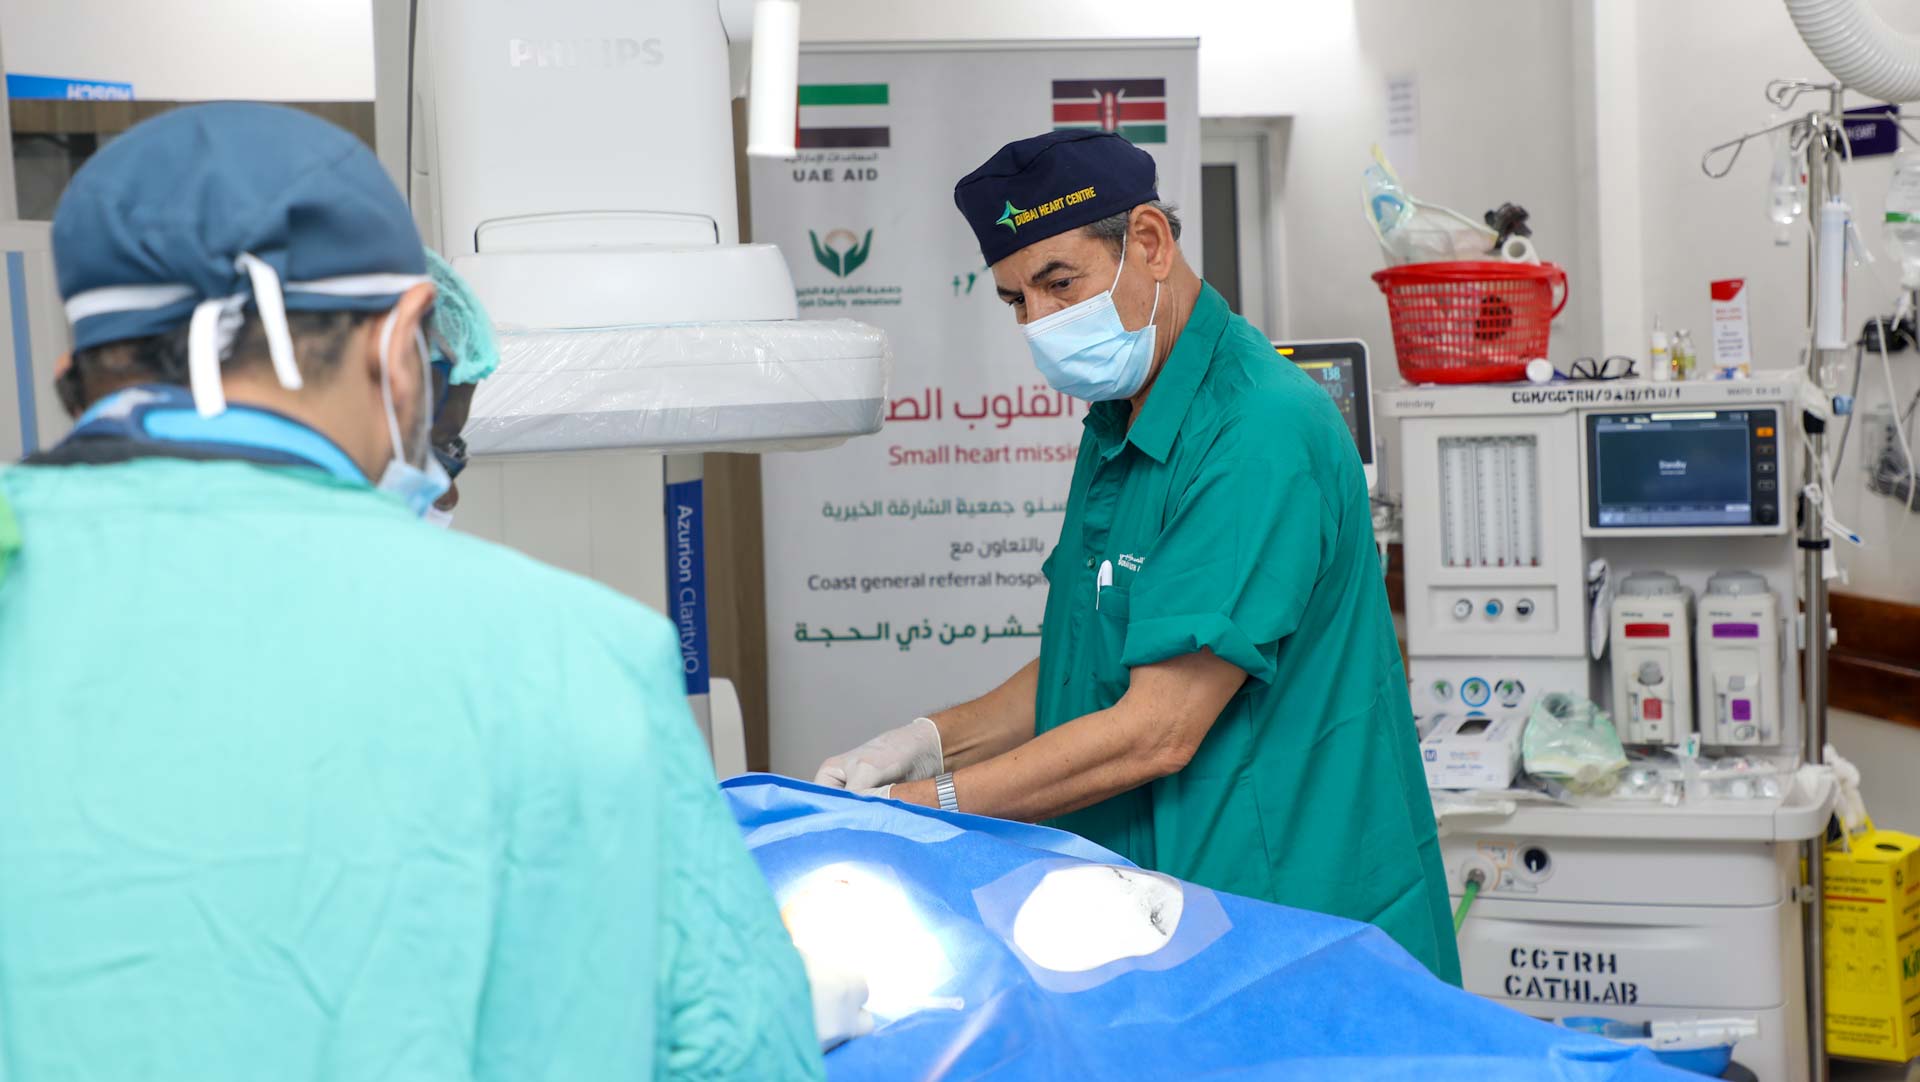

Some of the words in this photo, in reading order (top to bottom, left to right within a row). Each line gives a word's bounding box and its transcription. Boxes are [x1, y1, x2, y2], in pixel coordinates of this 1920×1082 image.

[509, 38, 664, 67] PHIIPS
[793, 168, 833, 182] UAE
[843, 168, 878, 181] AID
[1014, 208, 1040, 226] DUBAI
[1038, 198, 1065, 217] HEART
[1065, 186, 1097, 206] CENTRE
[889, 446, 949, 465] Small
[954, 444, 1010, 463] heart
[955, 499, 1015, 518] جمعية
[677, 505, 694, 582] Azurion
[950, 541, 974, 560] مع
[977, 538, 1045, 557] بالتعاون
[808, 575, 857, 590] Coast
[860, 574, 926, 593] general
[929, 573, 993, 587] referral
[794, 622, 890, 648] الحجة
[896, 619, 932, 651] ذي
[938, 624, 976, 645] من
[1510, 948, 1617, 974] CGTRH
[1504, 975, 1638, 1005] CATHLAB
